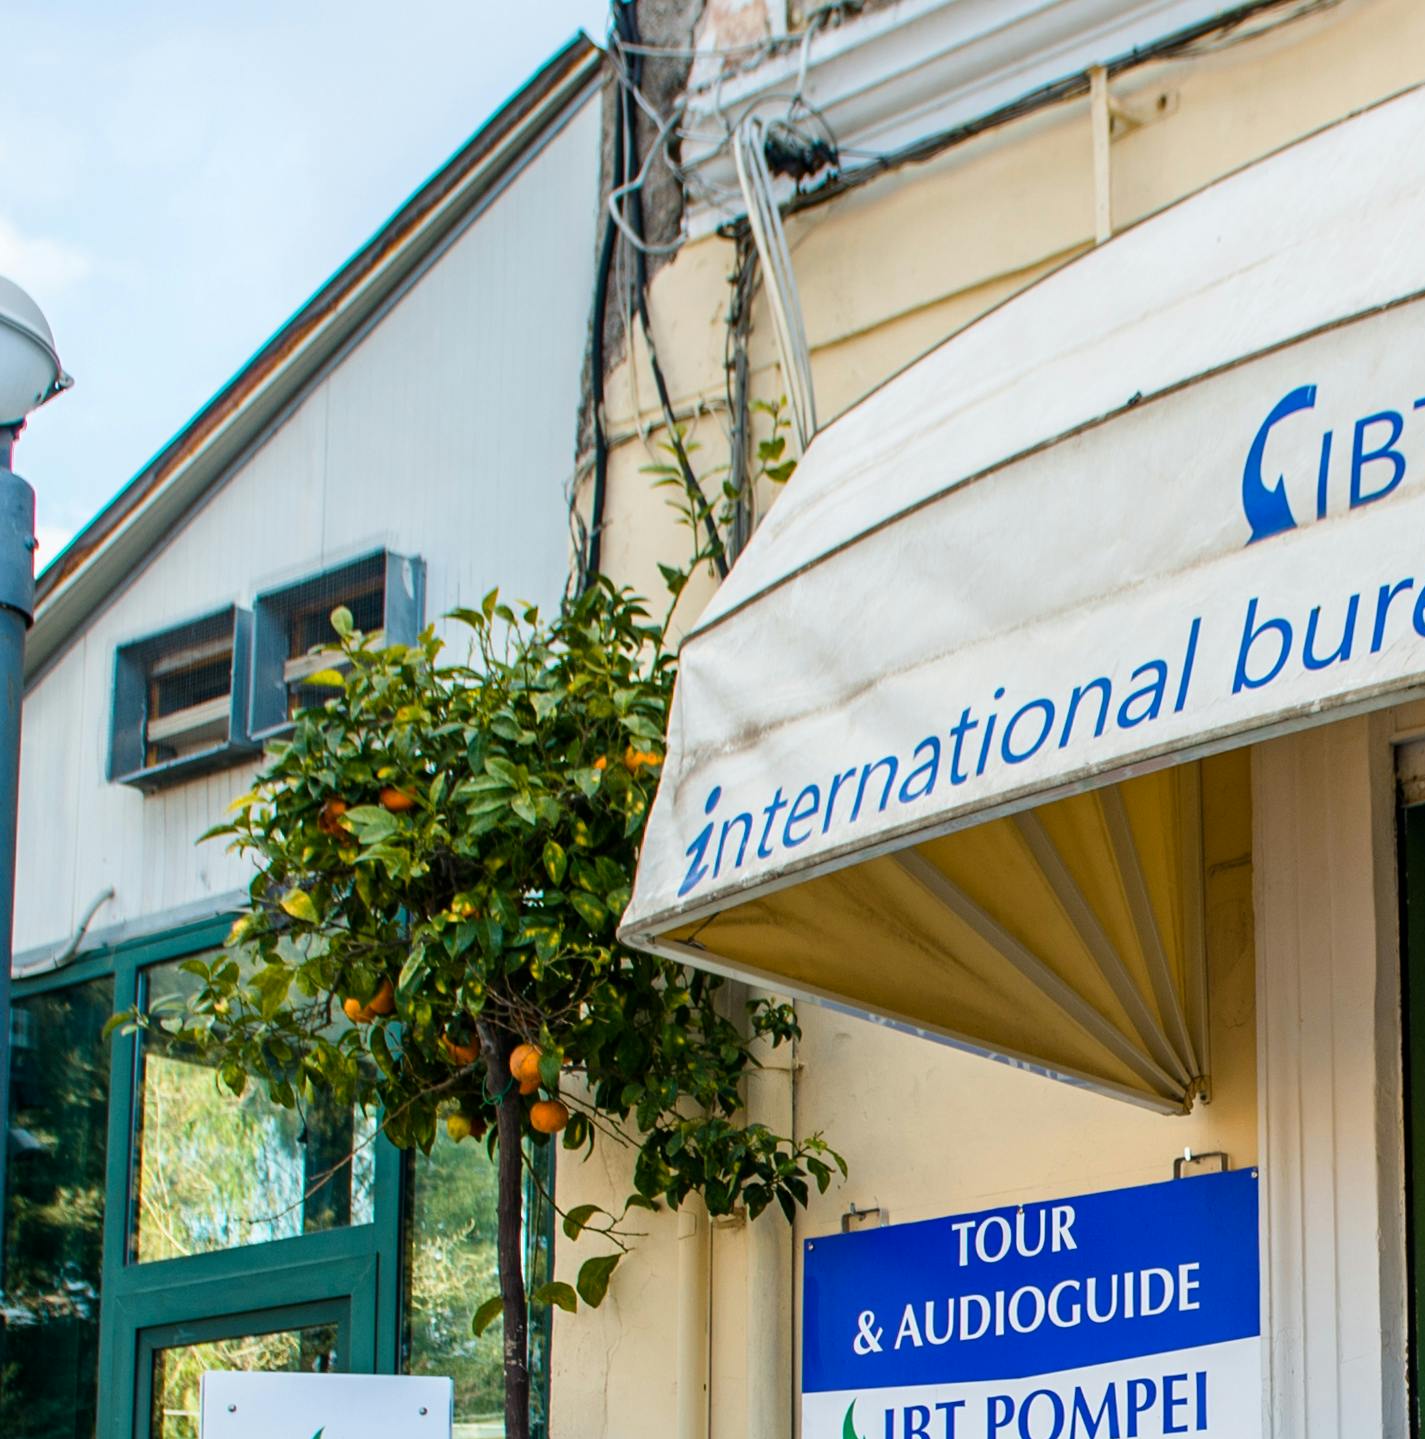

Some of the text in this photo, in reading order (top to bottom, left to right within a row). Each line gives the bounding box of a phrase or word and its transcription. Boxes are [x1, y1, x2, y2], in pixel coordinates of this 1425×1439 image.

[676, 616, 1202, 897] international
[951, 1205, 1078, 1268] TOUR
[853, 1261, 1200, 1355] & AUDIOGUIDE
